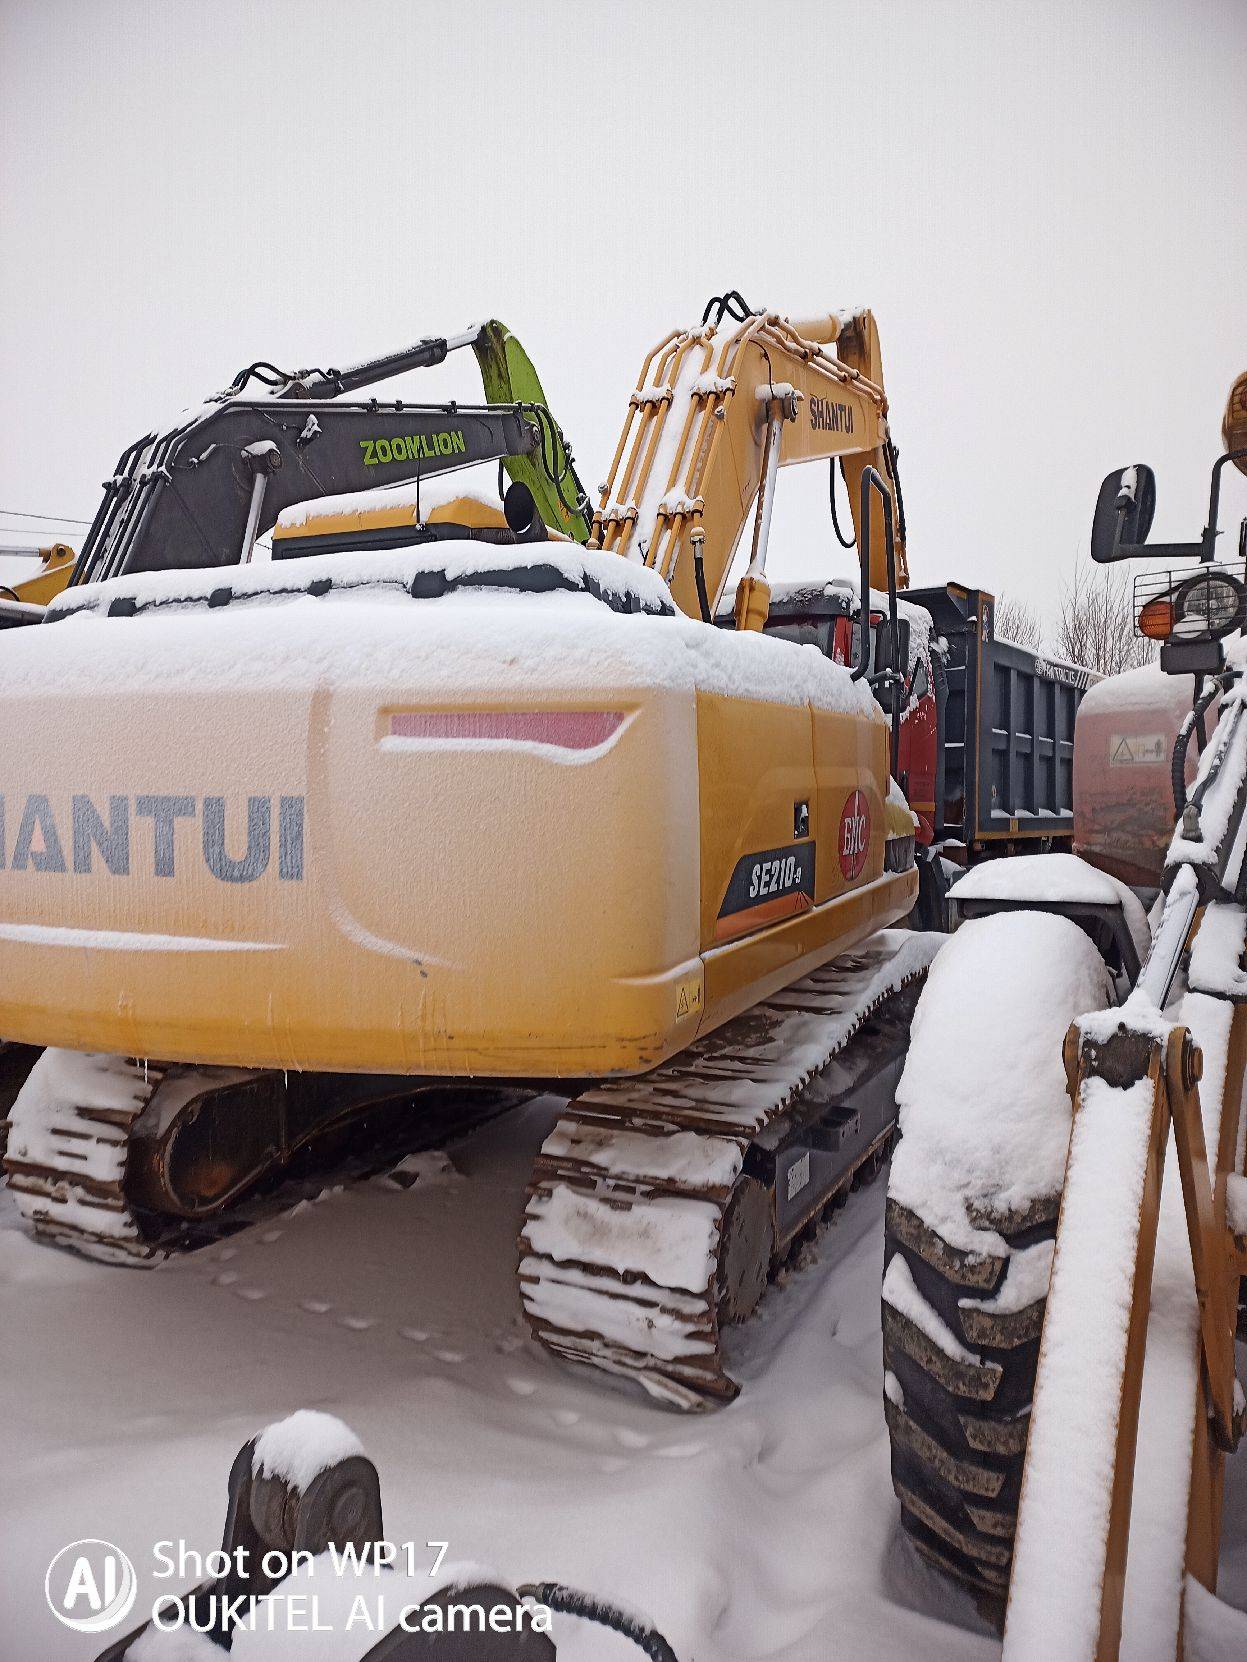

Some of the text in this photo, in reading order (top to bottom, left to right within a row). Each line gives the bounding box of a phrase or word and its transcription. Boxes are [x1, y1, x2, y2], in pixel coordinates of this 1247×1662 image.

[809, 396, 854, 434] SHANTUI
[359, 430, 466, 465] ZOOMLION
[0, 794, 305, 884] ANTUI
